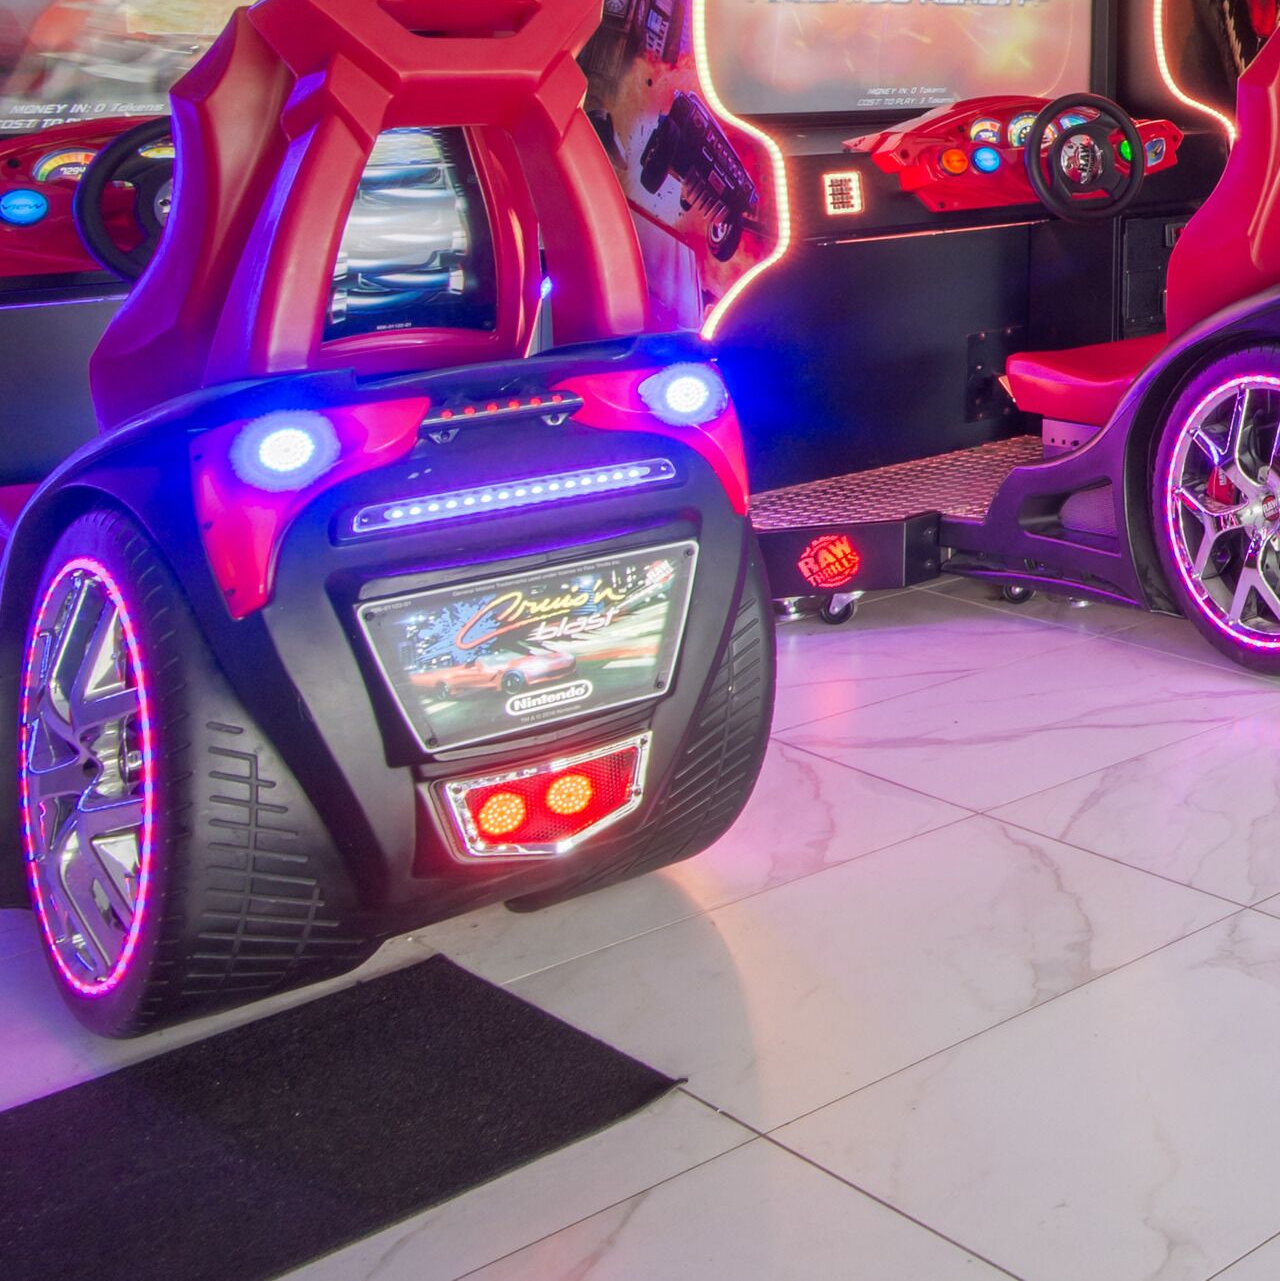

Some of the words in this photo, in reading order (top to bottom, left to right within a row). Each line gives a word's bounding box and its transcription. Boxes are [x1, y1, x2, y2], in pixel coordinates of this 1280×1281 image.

[9, 104, 67, 114] MONEY
[70, 103, 90, 113] IN:
[110, 102, 165, 112] Tokens
[798, 536, 851, 578] RAW
[807, 552, 859, 587] THRILLS
[530, 608, 621, 642] blast
[513, 686, 586, 710] Nintendo
